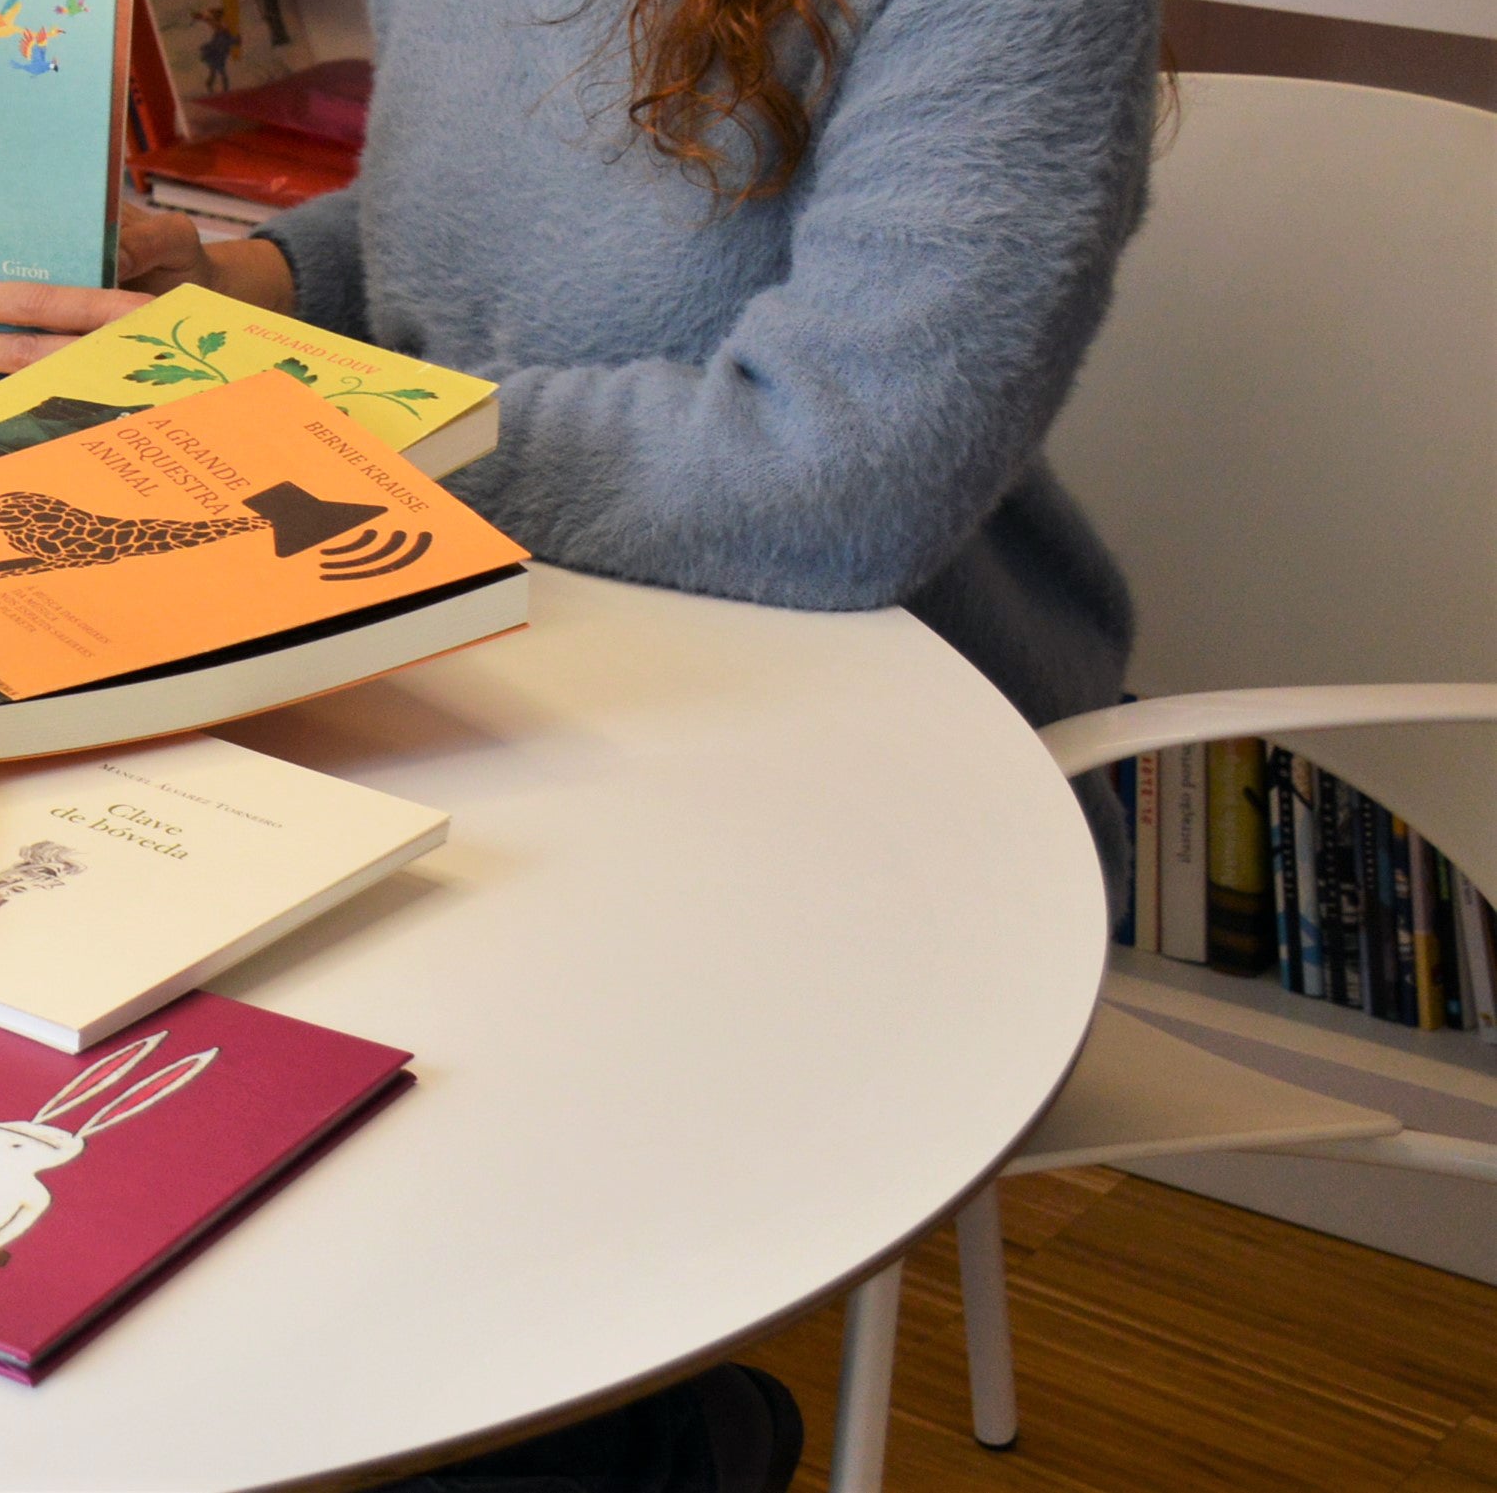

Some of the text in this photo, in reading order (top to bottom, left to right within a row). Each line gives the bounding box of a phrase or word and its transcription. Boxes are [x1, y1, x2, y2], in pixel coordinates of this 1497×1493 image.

[2, 257, 50, 280] Girón
[242, 323, 382, 377] RICHARD LOUV
[81, 440, 162, 498] ANIMAL
[116, 427, 231, 518] ORQUESTRA
[147, 419, 251, 492] A GRANDE
[303, 420, 429, 514] BERNIE KRAUSE
[98, 762, 283, 828] MANUEL ÁLVAREZ TORNEIRO
[107, 803, 183, 837] Clave
[50, 805, 188, 861] de bóveda
